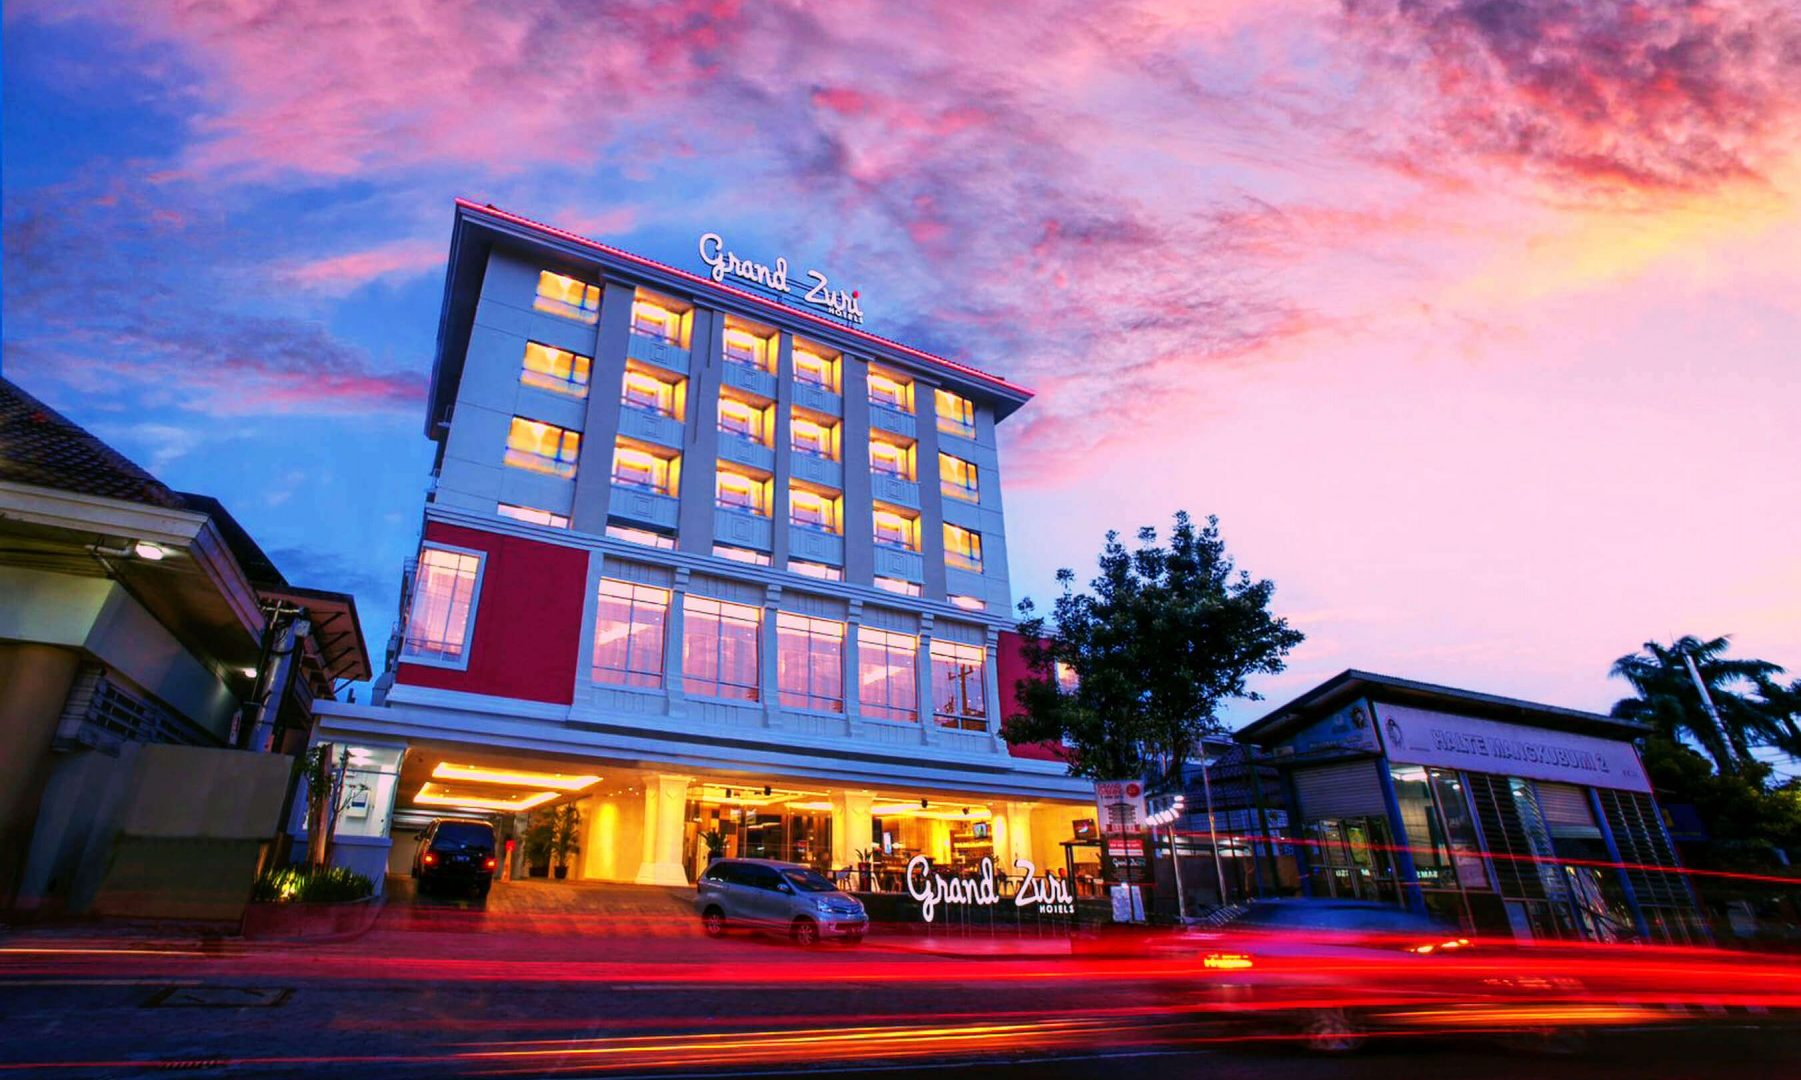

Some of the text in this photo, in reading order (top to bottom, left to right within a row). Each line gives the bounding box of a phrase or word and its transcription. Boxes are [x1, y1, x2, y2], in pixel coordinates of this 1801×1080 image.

[699, 233, 864, 316] Grand Zuri
[1431, 728, 1489, 756] HALTE
[907, 855, 999, 923] Grand
[1014, 858, 1072, 907] Zuri
[1039, 904, 1075, 914] HOTELS
